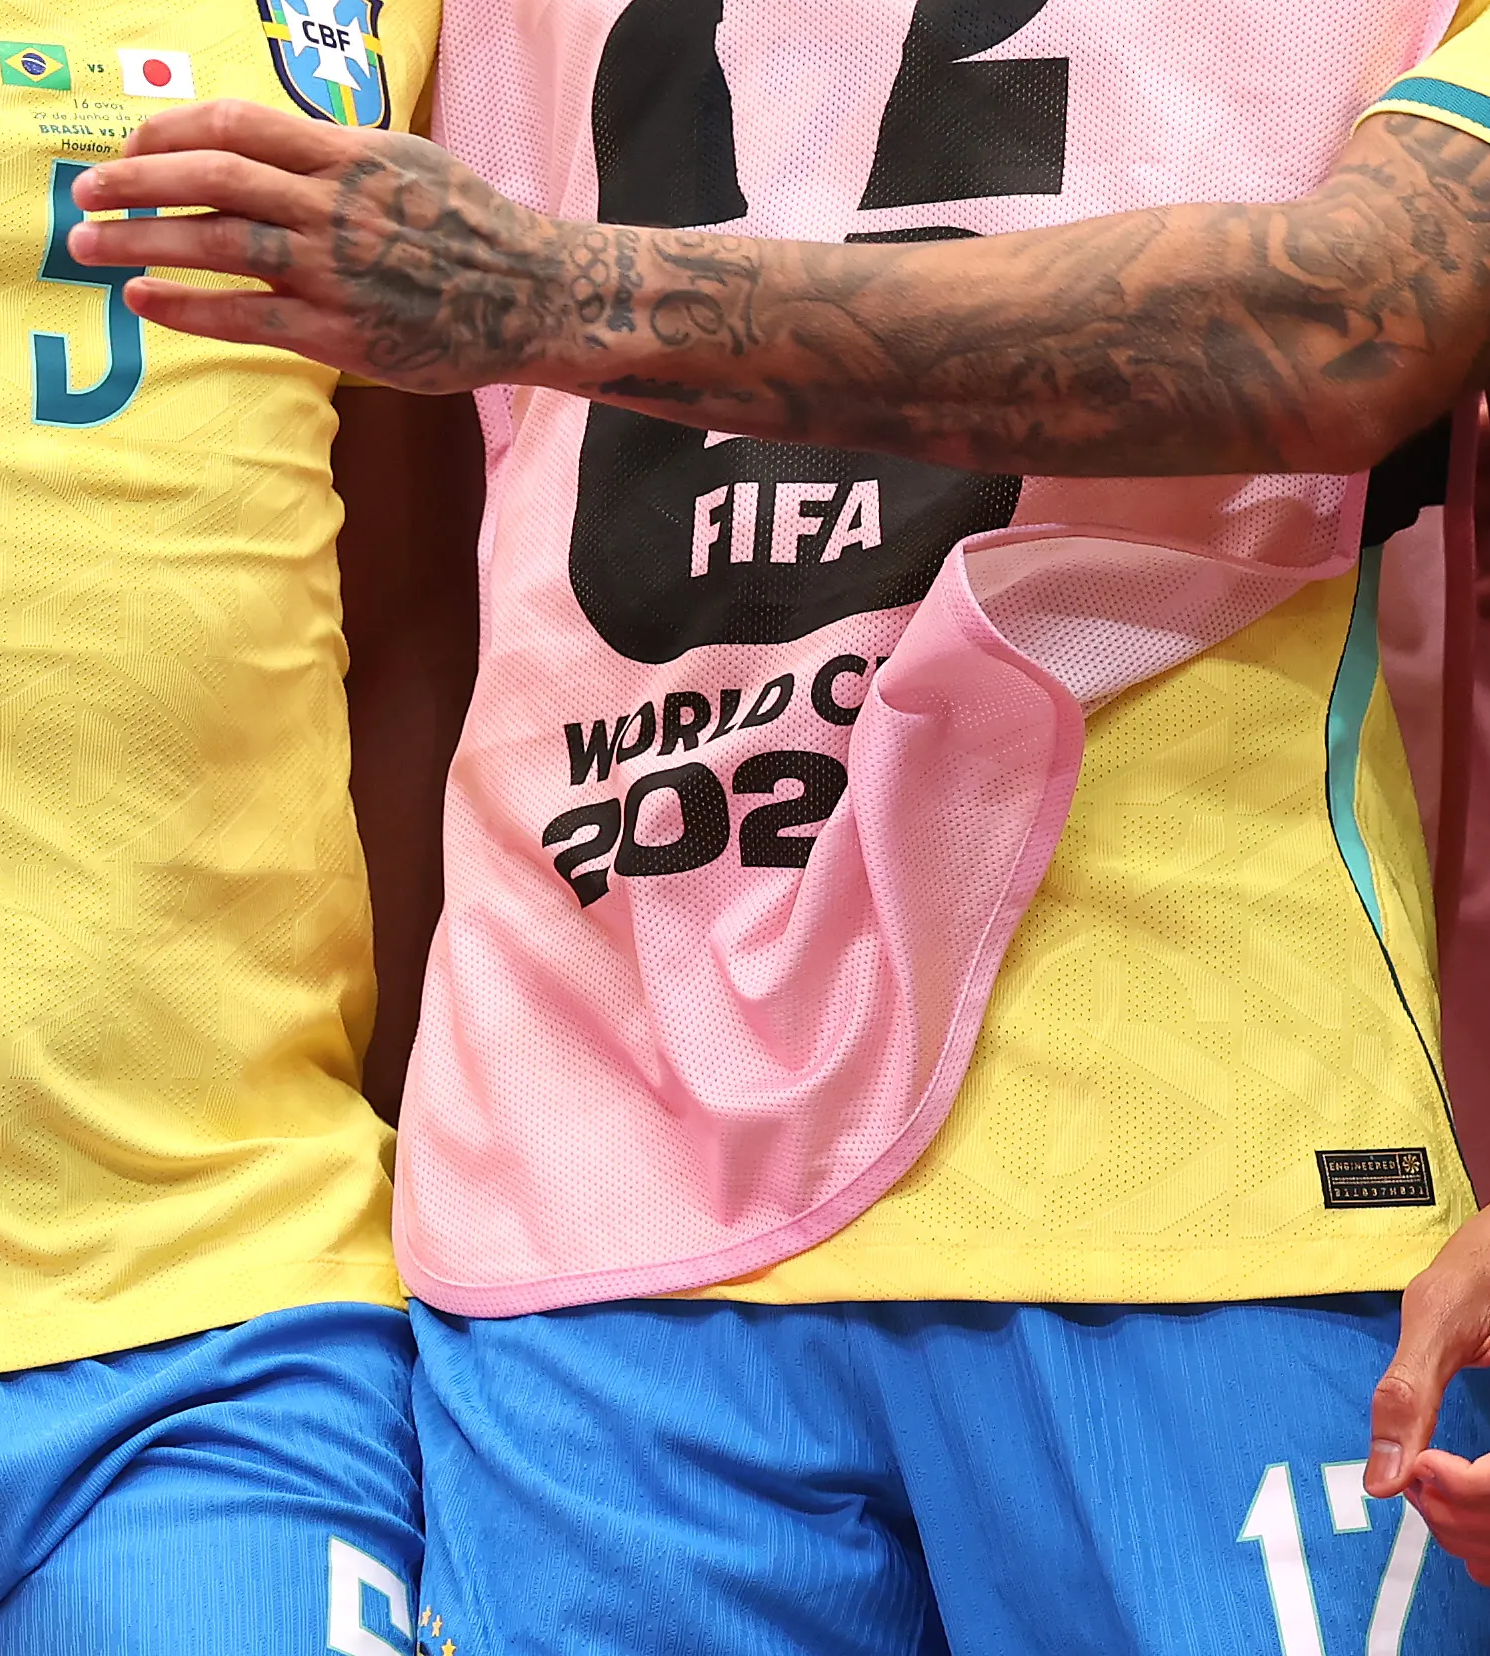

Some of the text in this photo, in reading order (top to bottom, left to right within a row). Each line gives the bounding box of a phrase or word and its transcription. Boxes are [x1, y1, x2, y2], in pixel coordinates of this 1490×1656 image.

[302, 20, 351, 52] CBF
[61, 139, 111, 153] Houston
[73, 98, 89, 109] 16
[28, 158, 160, 429] 5
[690, 479, 883, 579] FIFA
[563, 672, 795, 787] WORLD
[542, 749, 849, 909] 202
[1236, 1459, 1433, 1656] 17
